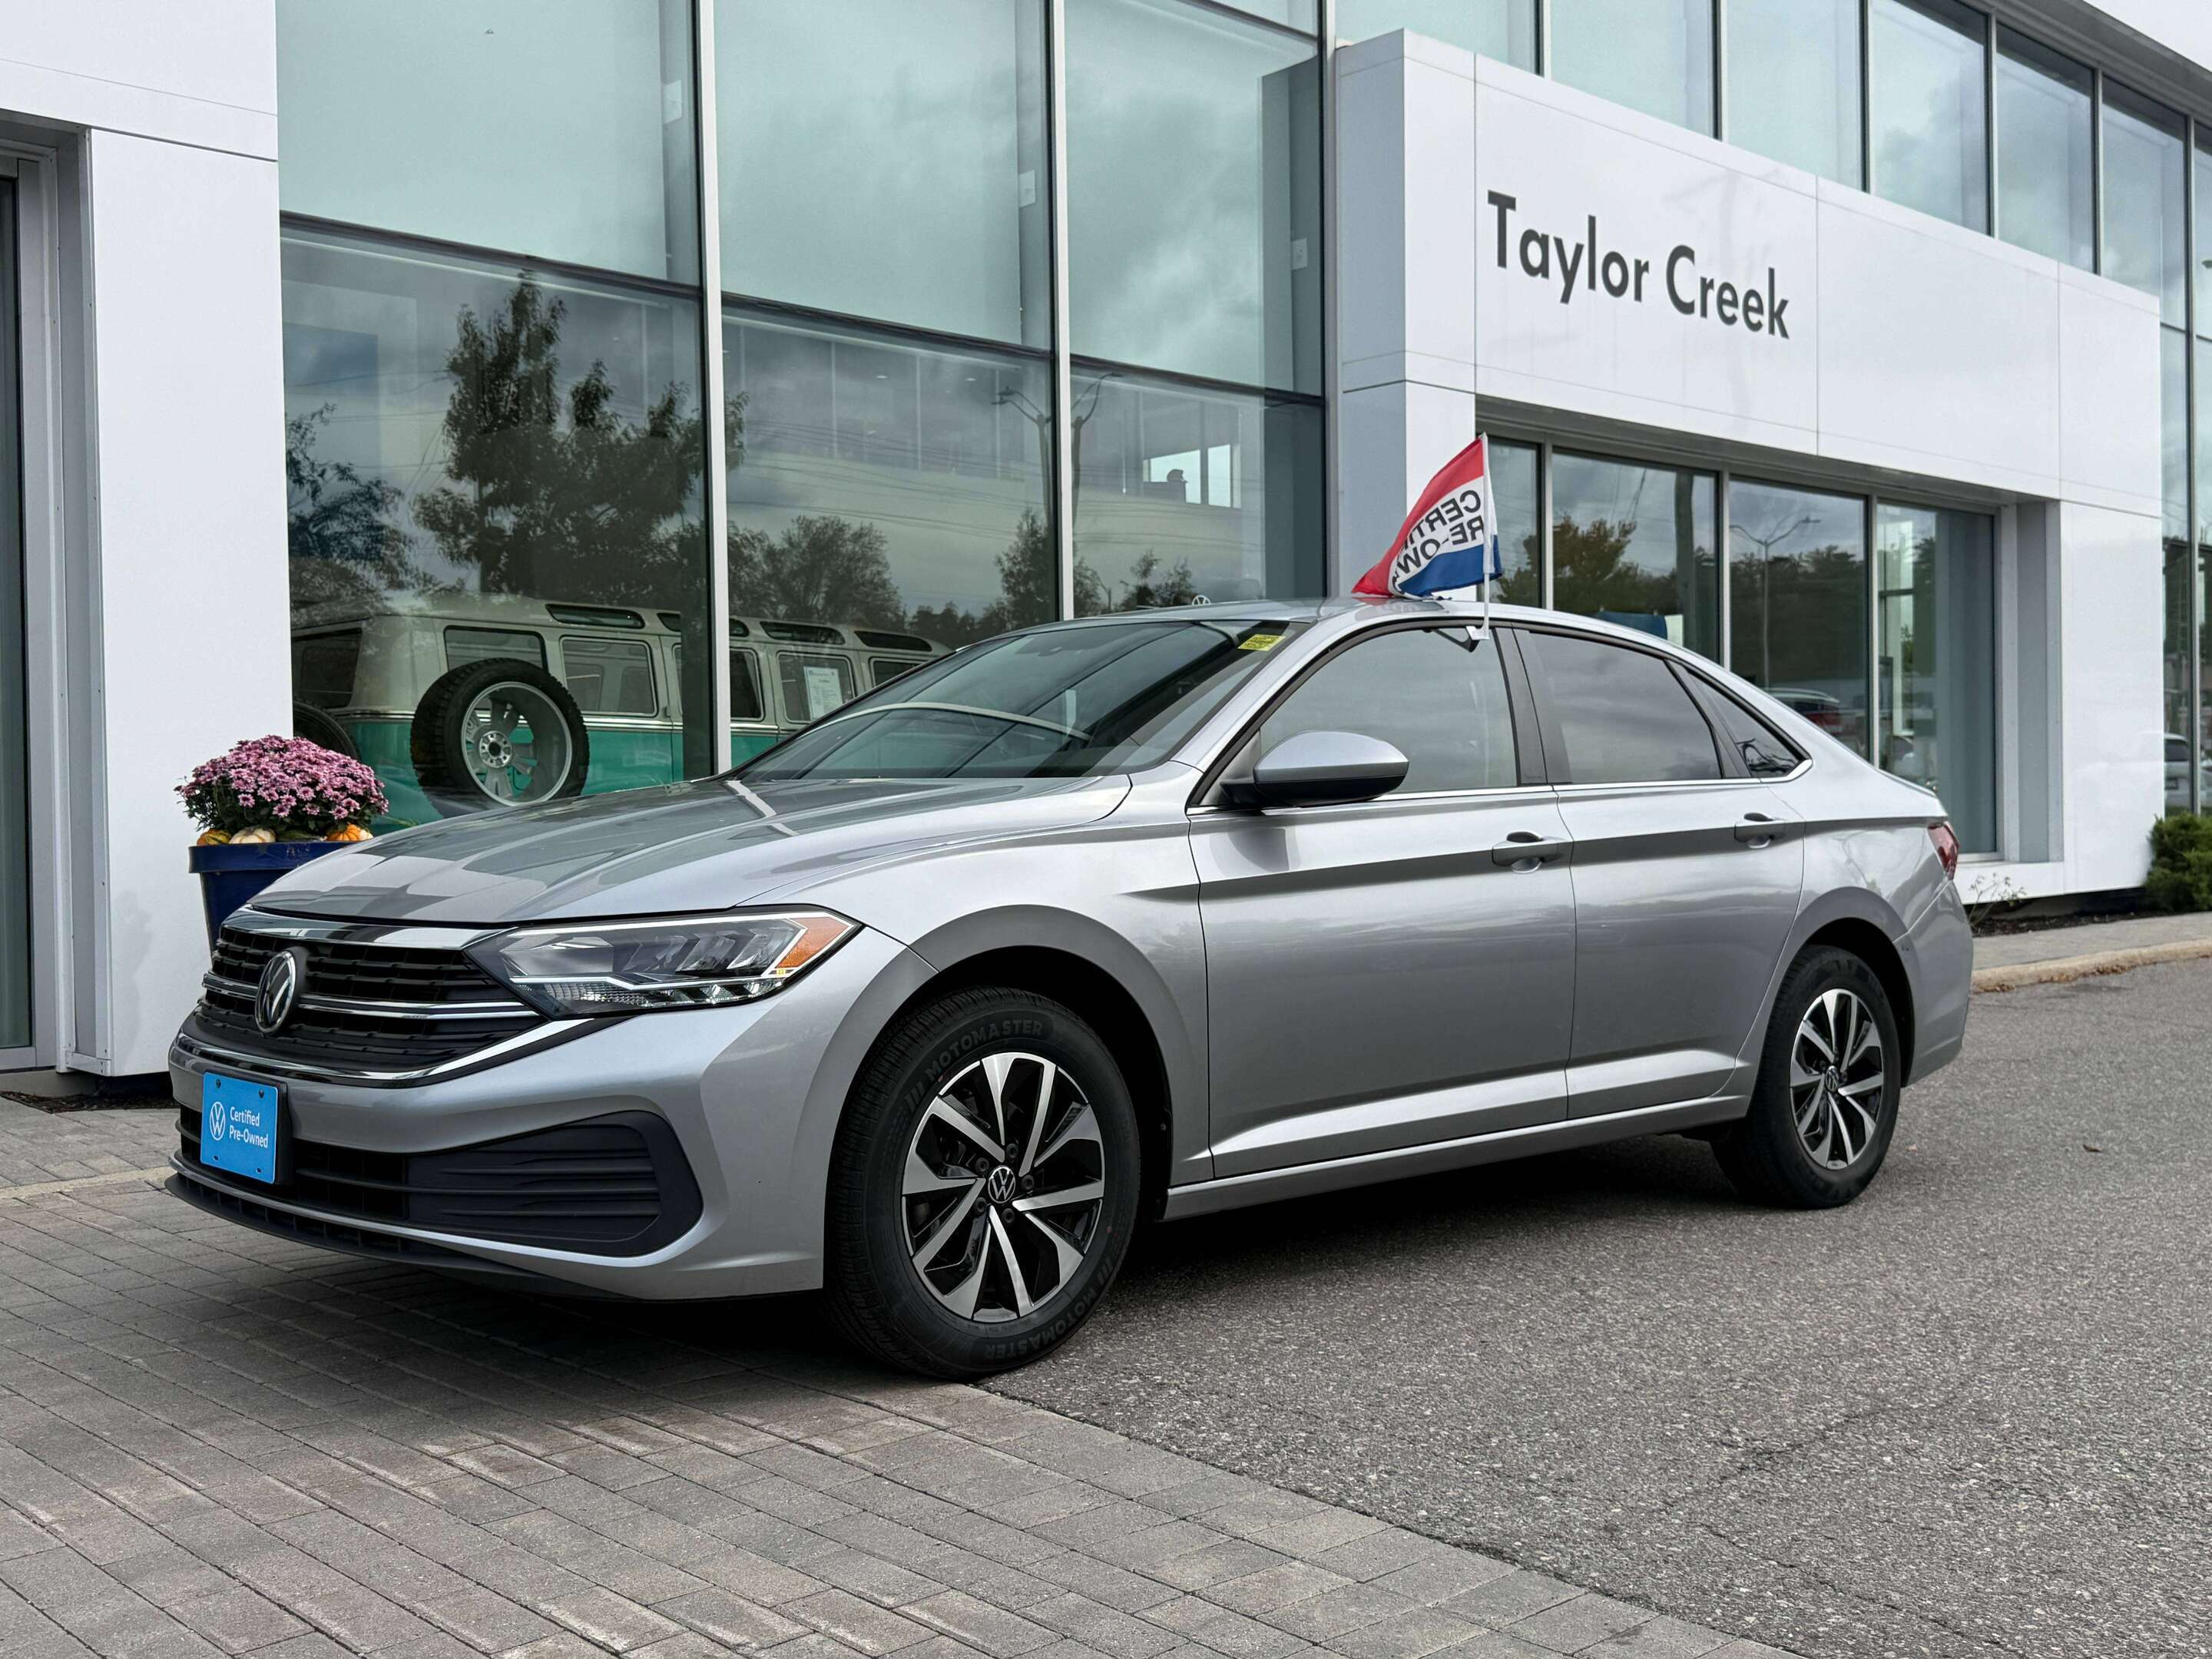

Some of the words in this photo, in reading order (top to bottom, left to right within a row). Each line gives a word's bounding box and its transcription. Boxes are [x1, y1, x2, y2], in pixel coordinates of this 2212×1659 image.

[1487, 189, 1650, 305] Taylor
[1665, 244, 1790, 339] Creek
[923, 1018, 1044, 1082] MOTOMASTER
[209, 1101, 227, 1141] VW
[229, 1125, 269, 1148] Pre-Owned
[230, 1107, 260, 1127] Certified
[988, 1165, 1016, 1204] VW
